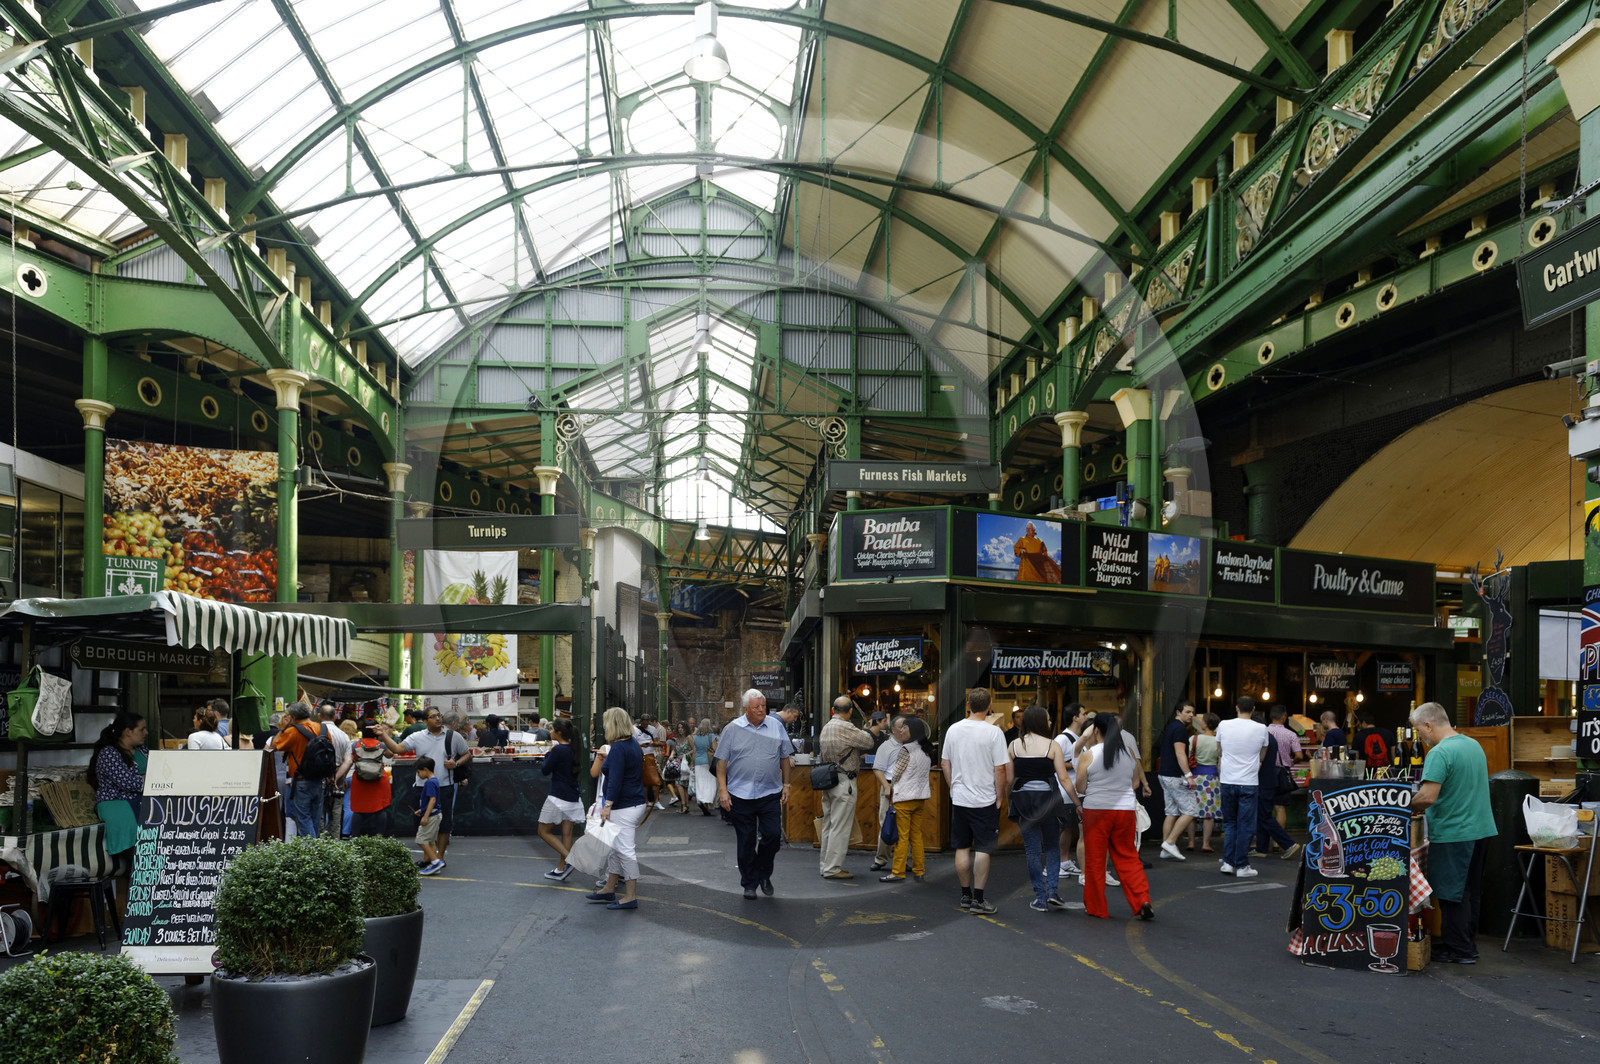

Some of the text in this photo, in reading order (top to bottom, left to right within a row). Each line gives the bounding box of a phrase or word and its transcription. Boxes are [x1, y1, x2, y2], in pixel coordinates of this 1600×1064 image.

[859, 468, 967, 482] Furness Fish Markets
[468, 524, 507, 539] Turnips
[862, 517, 921, 535] Bomba
[1102, 532, 1130, 549] Wild
[1092, 545, 1139, 564] Highland
[1216, 550, 1273, 571] Inshore Day Boat
[105, 557, 158, 571] TURNIPS
[1096, 561, 1131, 574] Venison
[1096, 571, 1132, 587] Burgers
[1223, 566, 1263, 584] Fresh Fish
[1313, 563, 1404, 596] Poultry & Game
[855, 638, 900, 654] Shetlands
[86, 646, 207, 666] BOROUGH MARKET
[856, 647, 915, 663] Salt & Pepper
[992, 649, 1092, 669] Furness Food Hut
[855, 657, 903, 674] Chilli Squid
[1054, 668, 1073, 676] Prepared
[1309, 662, 1357, 679] Scottish Highland
[1314, 675, 1330, 689] Wild
[144, 796, 259, 825] DAILY SPECIALS
[1325, 788, 1412, 816] PROSECCO
[1374, 814, 1401, 826] Bottle
[136, 824, 159, 841] MONDAY
[159, 823, 176, 839] ROAST
[1363, 825, 1371, 834] 2
[1386, 824, 1405, 836] £25
[135, 839, 157, 856] TUESDAY
[1345, 842, 1363, 855] Nice
[1370, 838, 1391, 850] Cold
[134, 854, 166, 871] WEDNESDAY
[1345, 852, 1363, 867] Free
[131, 869, 160, 886] THURSDAY
[160, 869, 175, 885] ROAST
[129, 885, 151, 901] FRIDAY
[151, 885, 171, 901] ROASTED
[124, 899, 153, 918] SATURDAY
[1305, 883, 1404, 933] £3.50
[170, 913, 187, 925] BEEF
[122, 926, 152, 946] SUNDAY
[155, 928, 165, 944] 3
[164, 929, 187, 943] COURSE
[186, 927, 202, 943] SET
[1303, 931, 1367, 956] A GLASS
